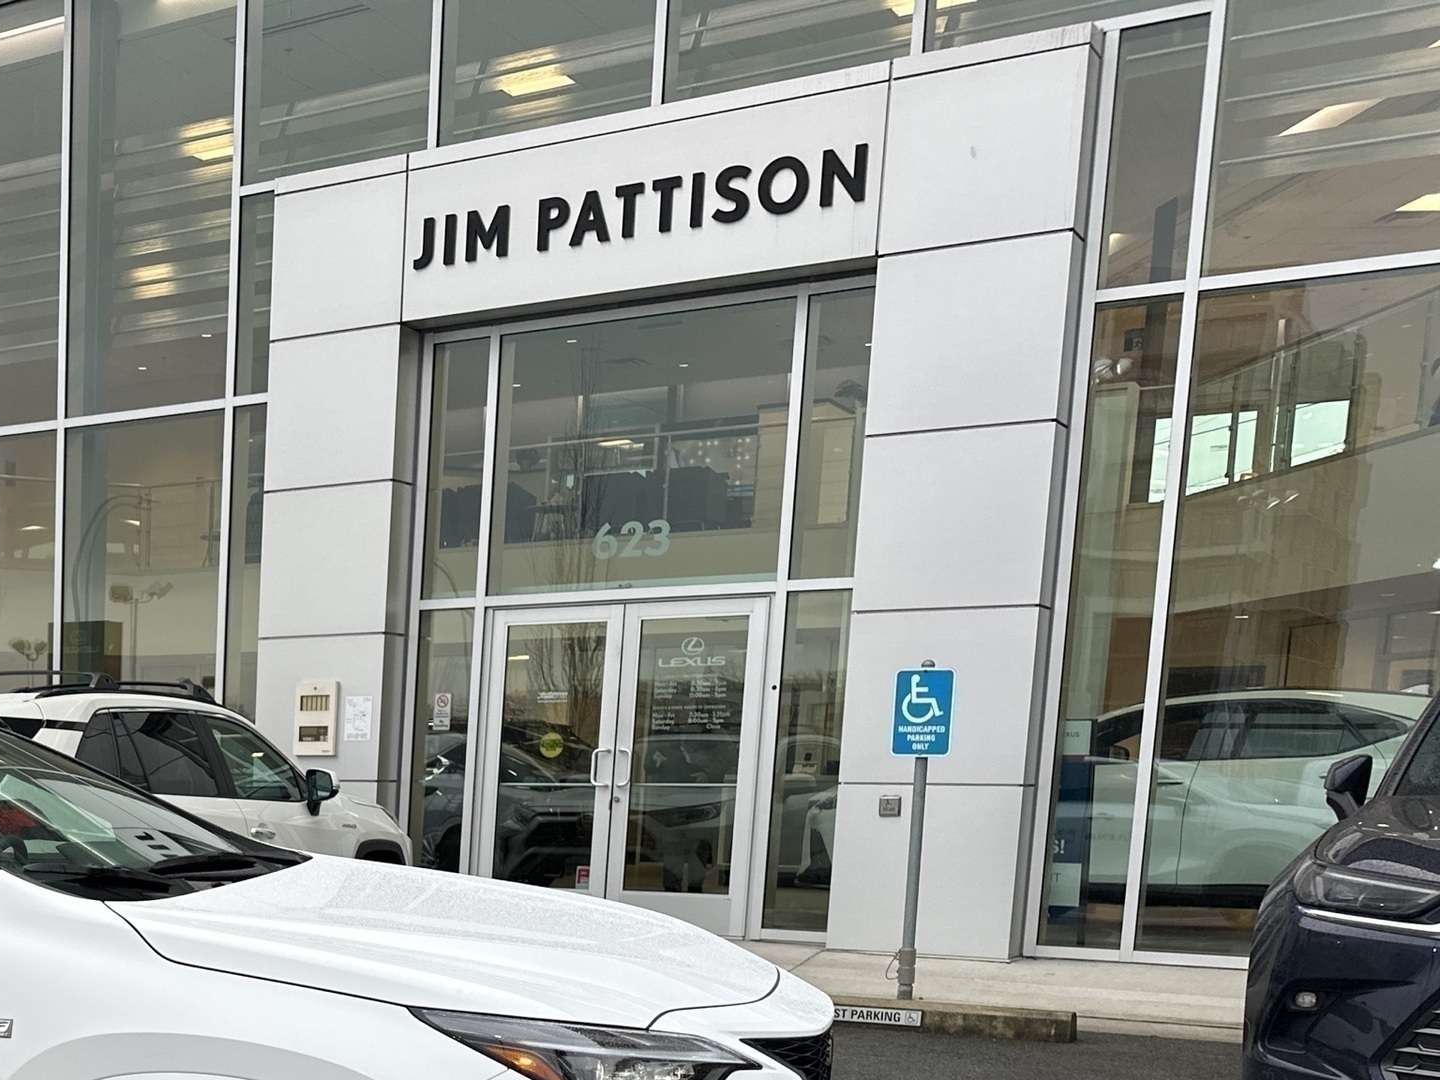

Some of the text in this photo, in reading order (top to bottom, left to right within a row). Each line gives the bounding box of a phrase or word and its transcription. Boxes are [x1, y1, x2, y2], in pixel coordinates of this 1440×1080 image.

[413, 143, 869, 270] JIM PATTISON
[592, 519, 671, 560] 623
[658, 656, 726, 667] LEXUS
[898, 725, 946, 733] HANDICAPPED
[906, 734, 936, 742] PARKING
[851, 1009, 901, 1022] PARKING
